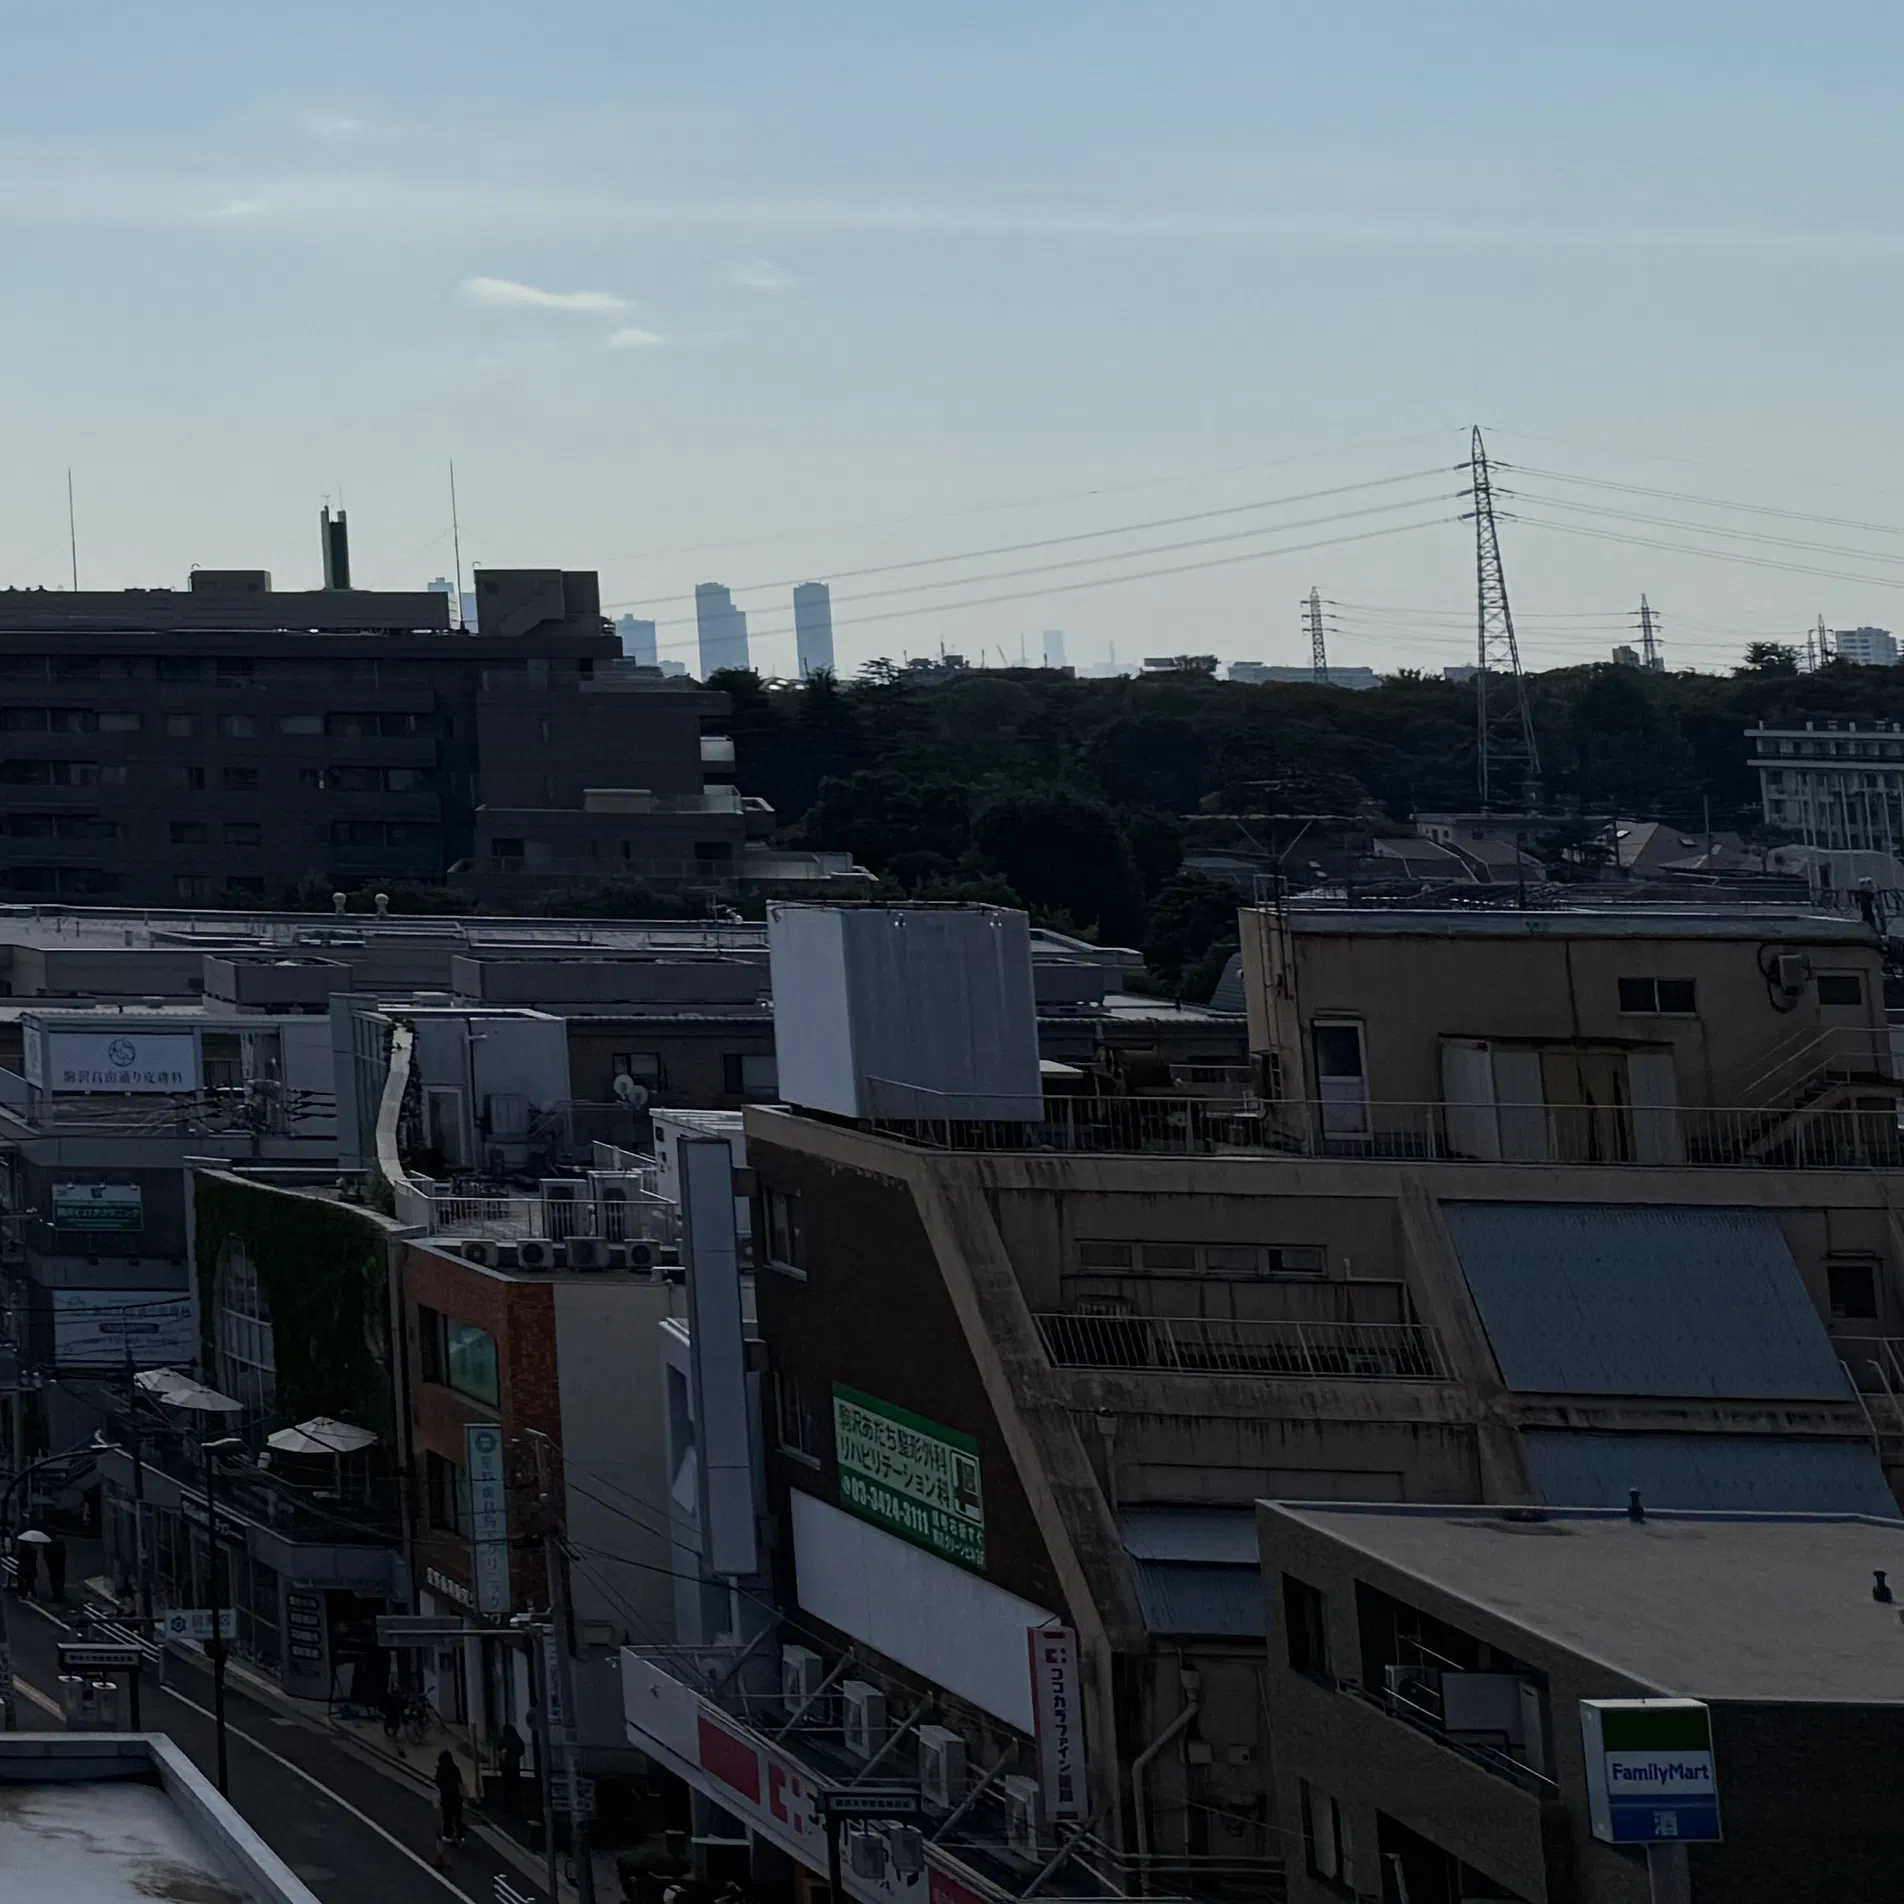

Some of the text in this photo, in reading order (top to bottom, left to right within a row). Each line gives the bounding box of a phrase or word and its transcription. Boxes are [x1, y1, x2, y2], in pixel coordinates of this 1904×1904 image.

[839, 1403, 948, 1476] 駒沢あだち整形外科
[839, 1436, 951, 1508] リハビリテーション科
[851, 1476, 930, 1534] 03-3424-3111
[1612, 1763, 1710, 1785] FamilyMart
